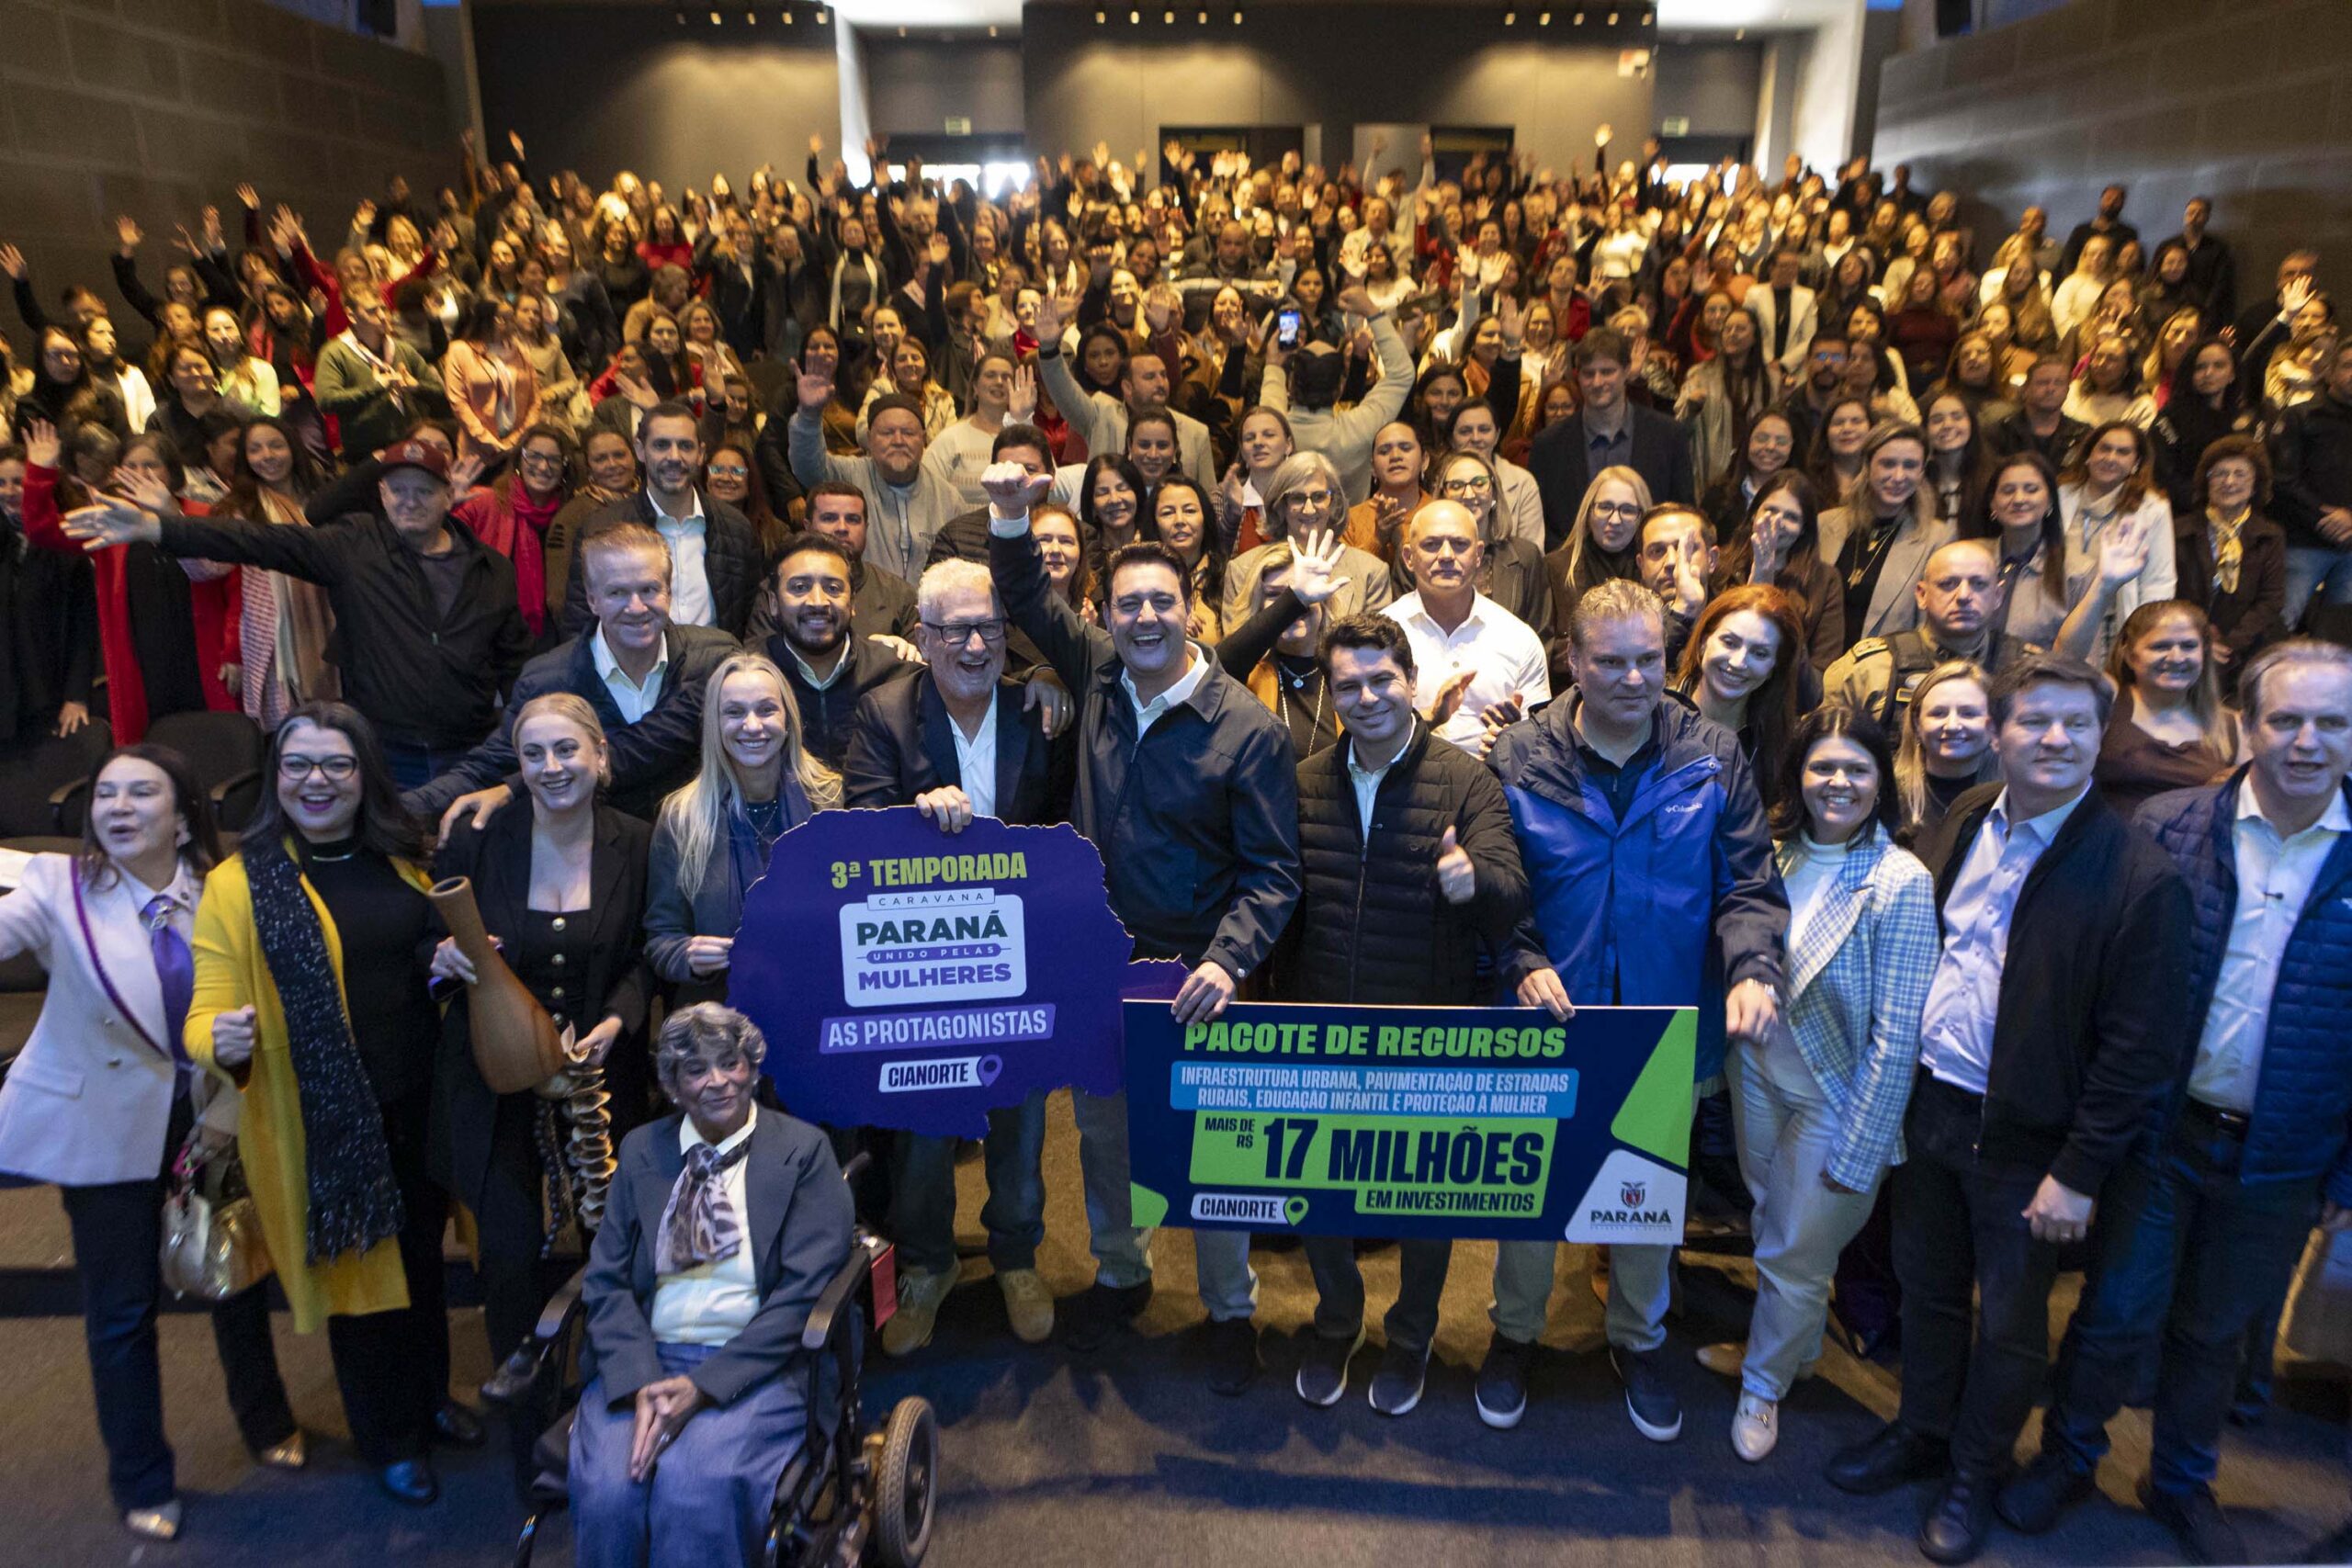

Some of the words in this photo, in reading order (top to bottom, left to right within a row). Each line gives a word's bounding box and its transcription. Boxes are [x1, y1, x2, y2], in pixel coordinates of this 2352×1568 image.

[831, 861, 861, 889] 3ª
[869, 852, 1028, 887] TEMPORADA
[878, 892, 984, 907] CARAVANA
[856, 909, 1009, 946] PARANÁ
[873, 950, 928, 961] UNIDO
[940, 946, 994, 956] PELAS
[858, 963, 1012, 991] MULHERES
[828, 1021, 858, 1048] AS
[864, 1009, 1047, 1044] PROTAGONISTAS
[1184, 1021, 1317, 1055] PACOTE
[1325, 1024, 1370, 1055] DE
[1376, 1026, 1566, 1058] RECURSOS
[888, 1062, 969, 1088] CIANORTE
[1181, 1066, 1298, 1088] INFRAESTRUTURA
[1302, 1070, 1361, 1090] URBANA,
[1365, 1071, 1471, 1094] PAVIMENTAÇÃO
[1476, 1074, 1493, 1092] DE
[1496, 1074, 1569, 1093] ESTRADAS
[1197, 1088, 1252, 1108] RURAIS,
[1255, 1089, 1328, 1111] EDUCAÇÃO
[1331, 1092, 1390, 1111] INFANTIL
[1392, 1094, 1401, 1111] E
[1404, 1092, 1476, 1114] PROTEÇÃO
[1490, 1095, 1547, 1113] MULHER
[1204, 1117, 1238, 1133] MAIS
[1239, 1118, 1255, 1133] DE
[1263, 1117, 1318, 1179] 17
[1328, 1125, 1544, 1186] MILHÕES
[1200, 1198, 1278, 1220] CIANORTE
[1365, 1190, 1392, 1209] EM
[1395, 1191, 1535, 1213] INVESTIMENTOS
[1590, 1209, 1671, 1224] PARANÁ
